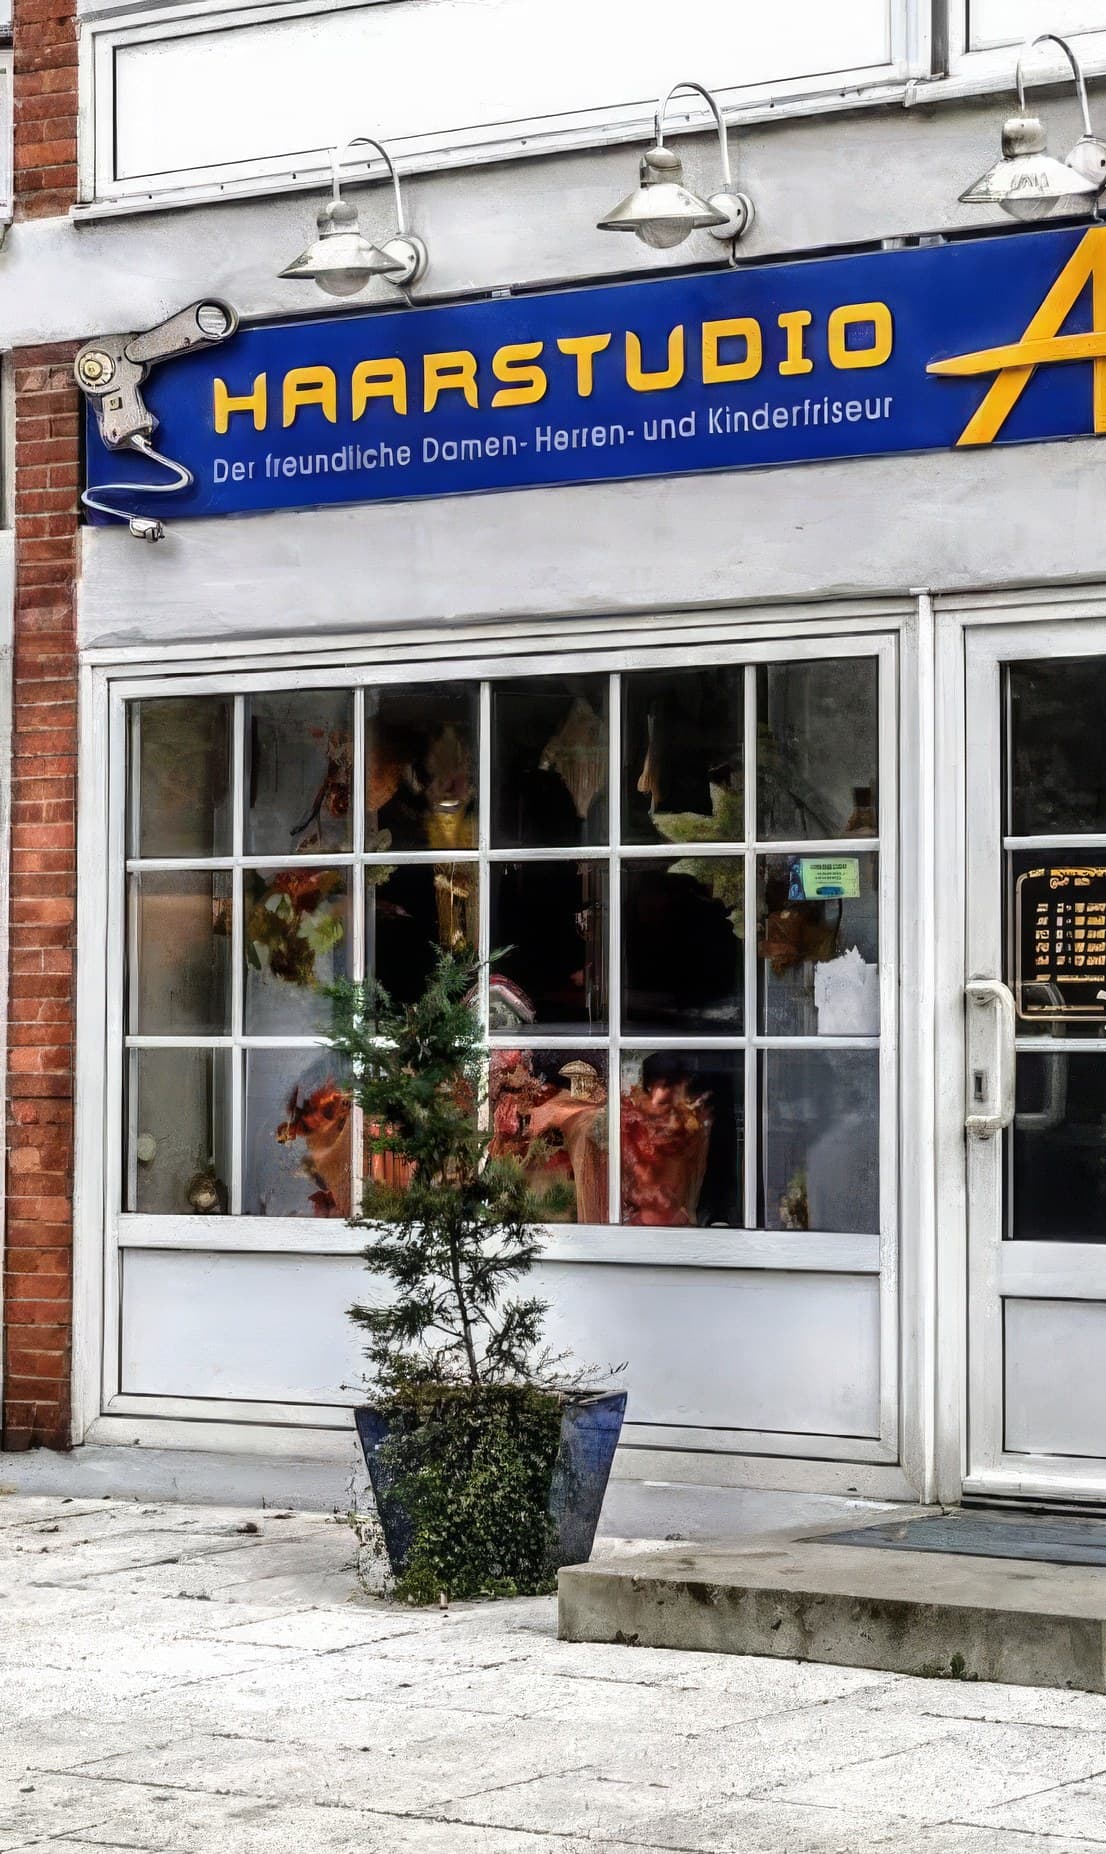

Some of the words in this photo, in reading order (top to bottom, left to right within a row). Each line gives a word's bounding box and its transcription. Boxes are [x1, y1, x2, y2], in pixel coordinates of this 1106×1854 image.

[213, 301, 893, 434] HAARSTUDIO
[213, 458, 255, 483] Der
[265, 442, 411, 478] freundliche
[423, 435, 529, 463] Damen-
[535, 425, 635, 452] Herren-
[643, 411, 696, 442] und
[708, 396, 893, 434] Kinderfriseur
